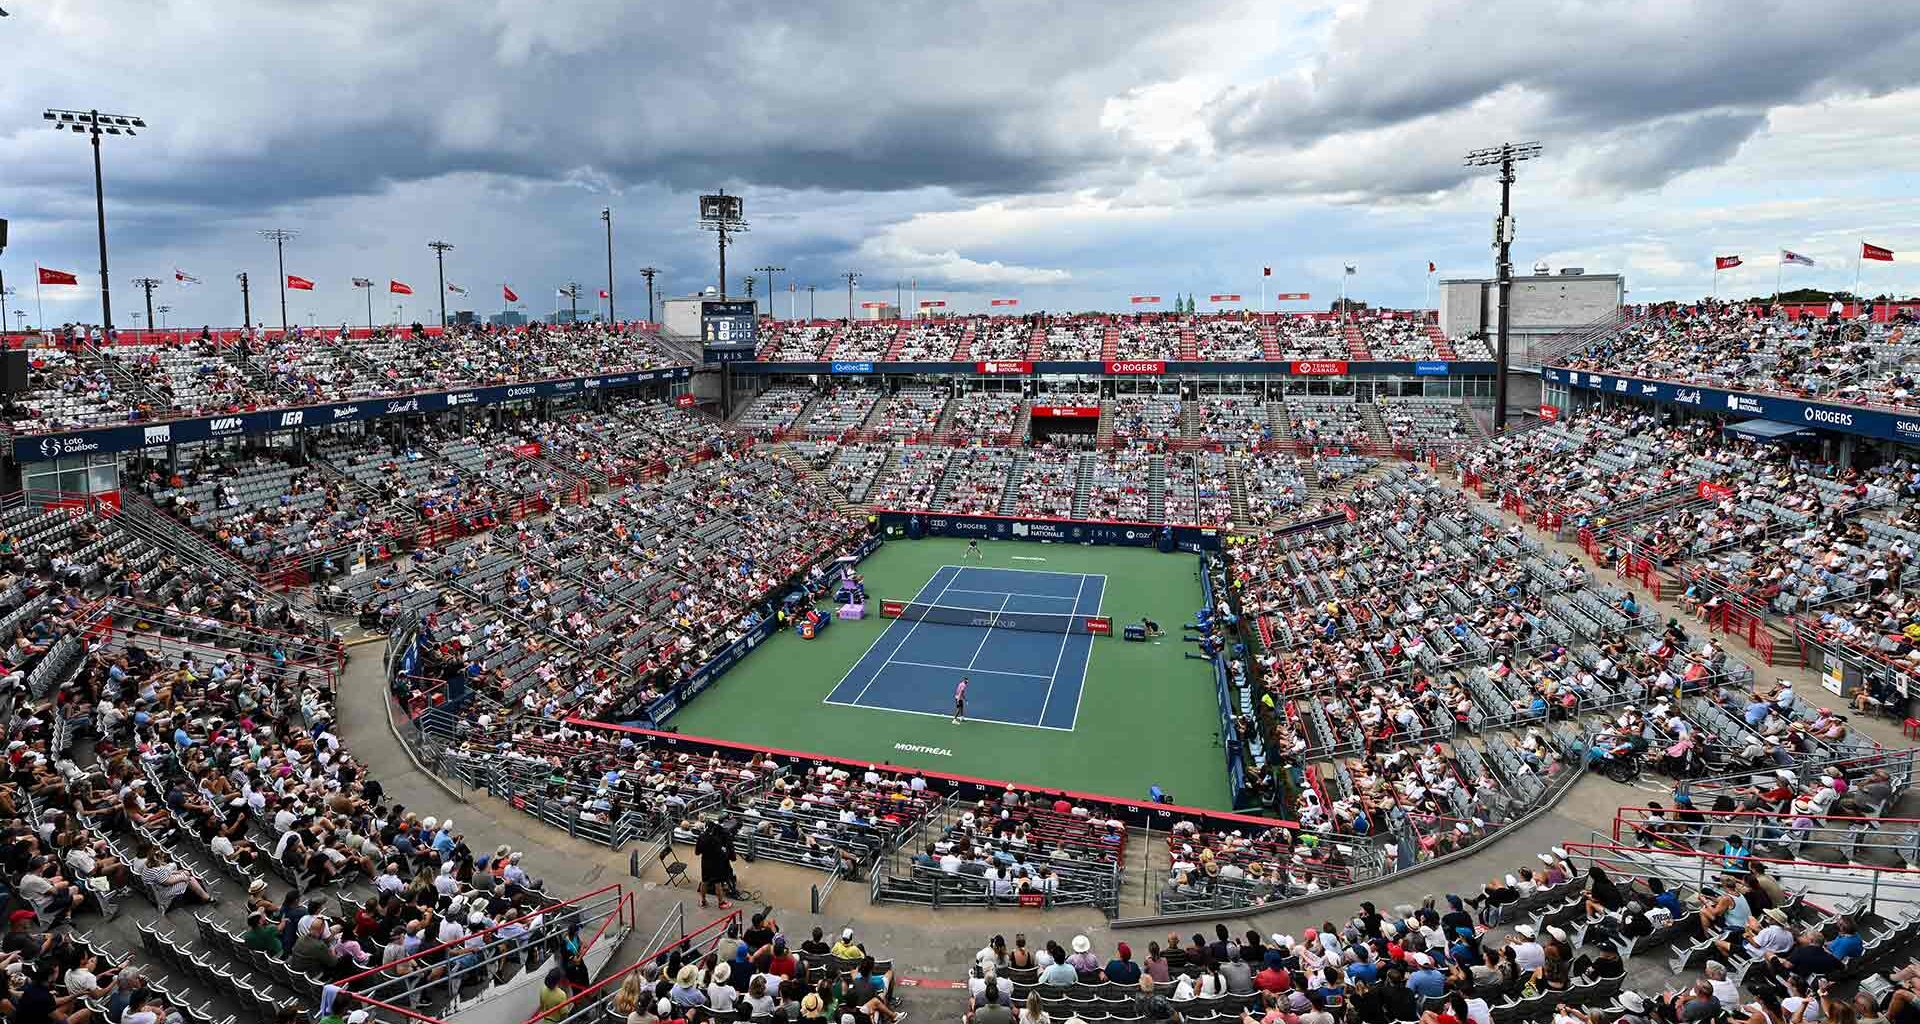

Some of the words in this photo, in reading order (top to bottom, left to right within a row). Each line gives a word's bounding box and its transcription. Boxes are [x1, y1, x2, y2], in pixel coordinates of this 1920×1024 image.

[1122, 363, 1158, 372] ROGERS
[514, 386, 536, 396] ROGERS
[1675, 389, 1695, 402] Lindt
[385, 400, 411, 414] Lindt
[281, 411, 303, 426] IGA
[1815, 409, 1853, 426] ROGERS
[210, 417, 235, 430] VIA
[63, 437, 83, 446] Loto
[145, 434, 171, 445] KIND
[1030, 524, 1056, 532] BANQUE
[1030, 529, 1065, 538] NATIONALE
